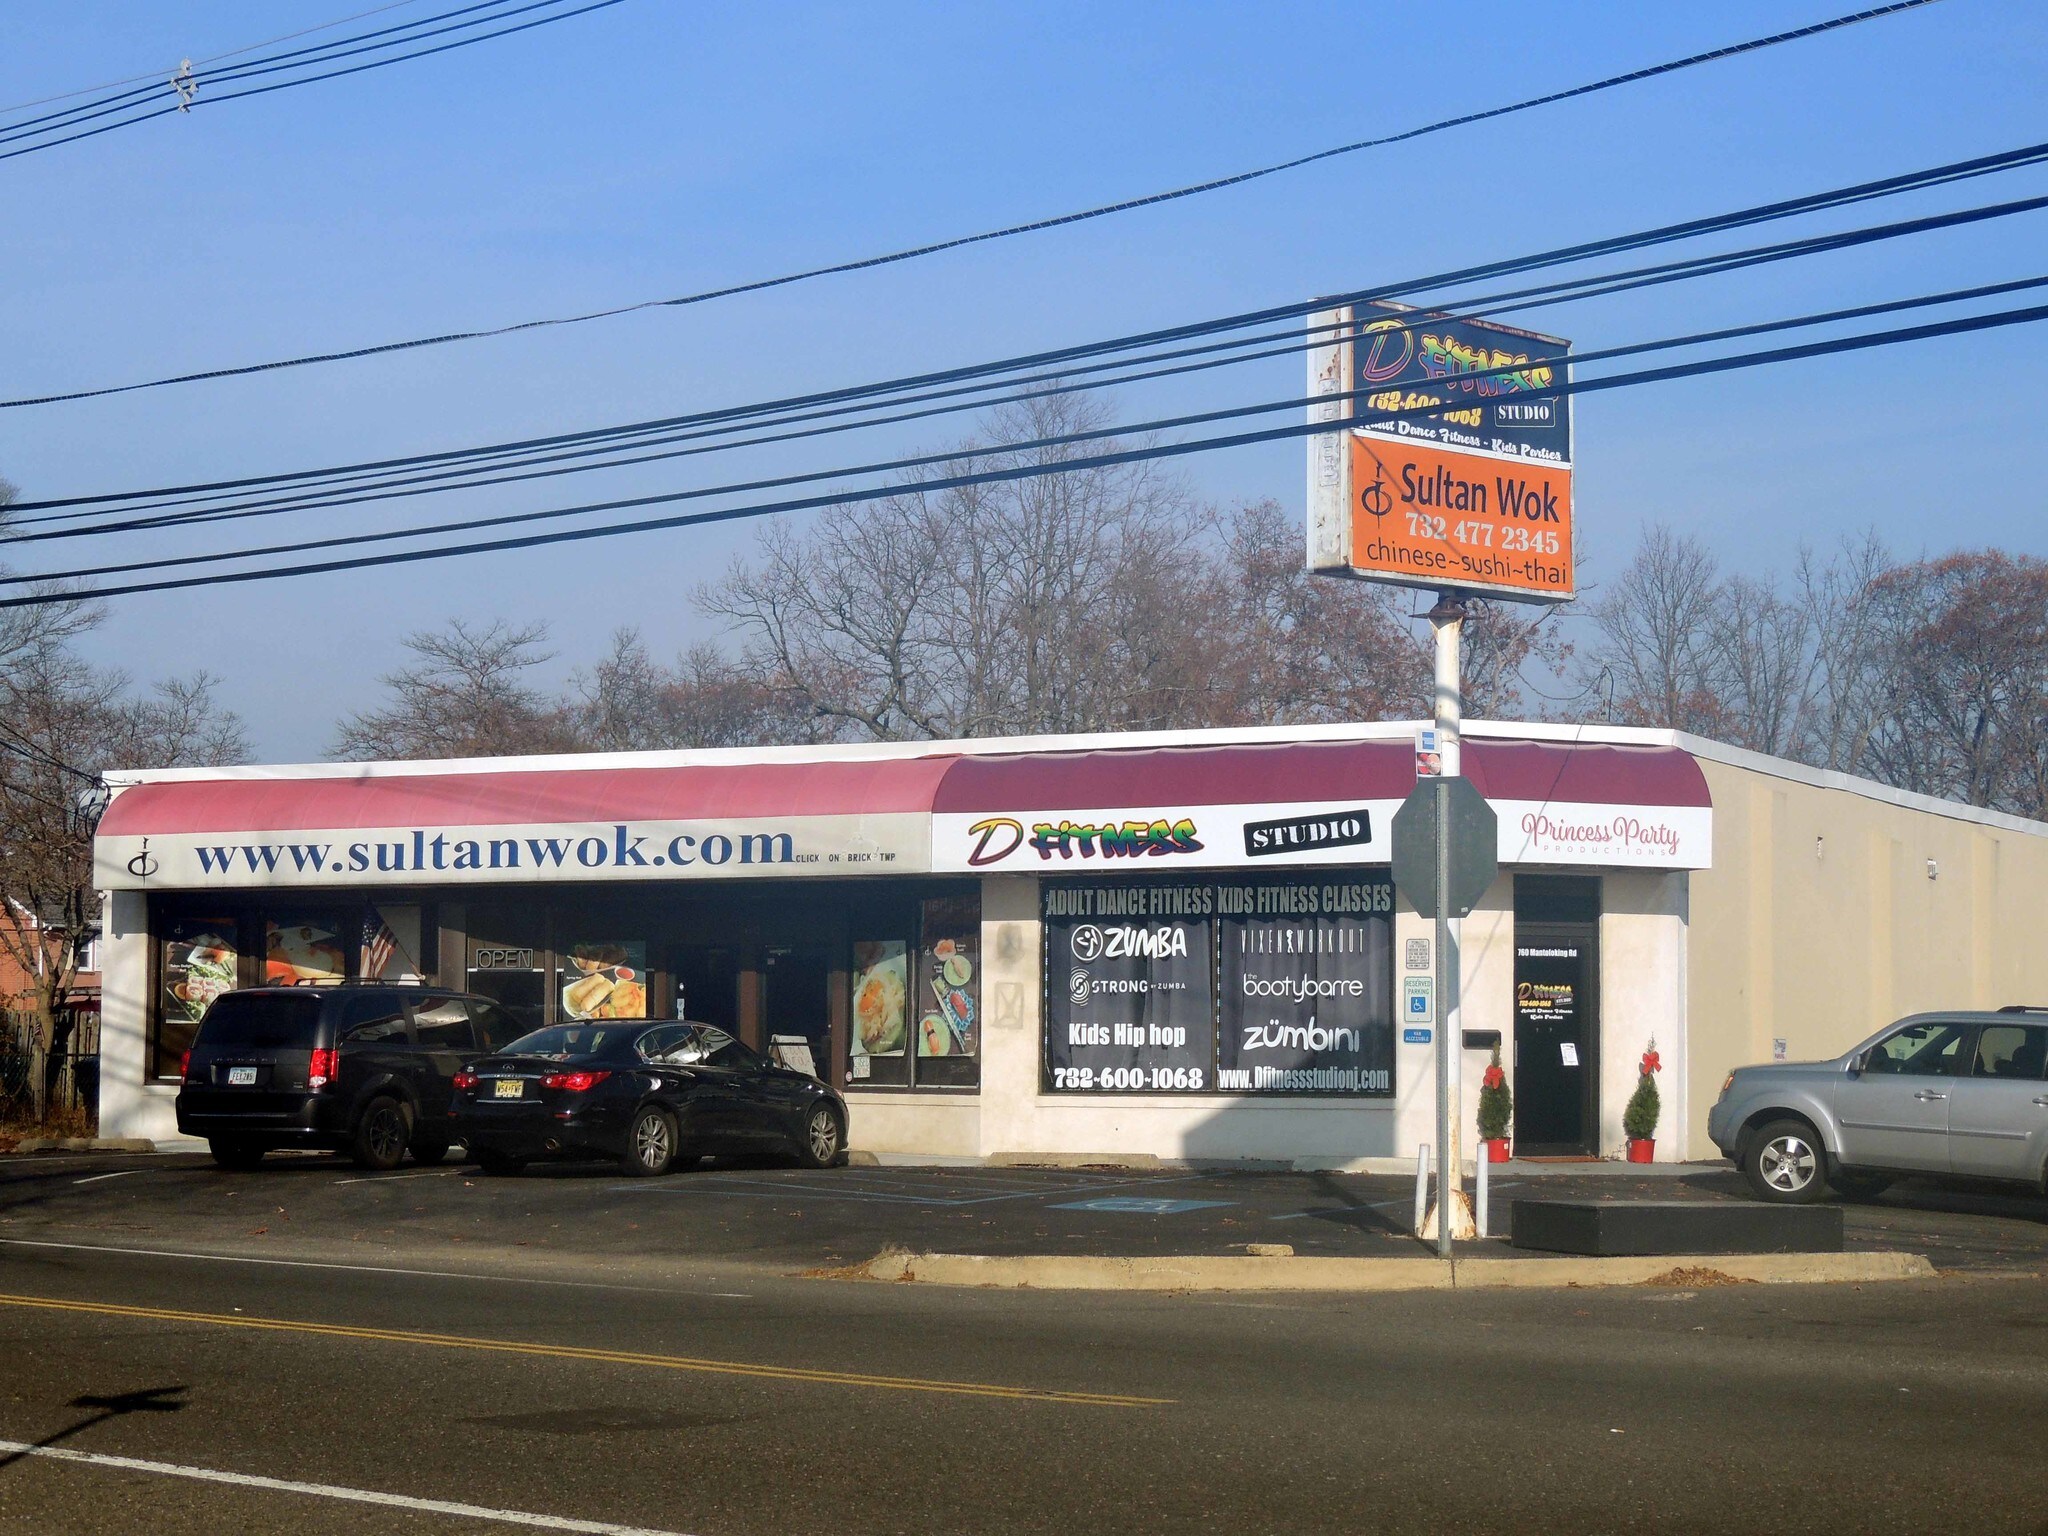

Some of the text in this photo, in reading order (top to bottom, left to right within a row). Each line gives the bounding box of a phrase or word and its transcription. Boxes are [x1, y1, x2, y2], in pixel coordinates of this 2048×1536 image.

[1363, 319, 1414, 382] D
[1497, 404, 1550, 421] STUDIO
[1397, 420, 1437, 438] Dance
[1438, 427, 1481, 447] Fitness
[1491, 438, 1518, 454] Kids
[1520, 443, 1562, 461] Parties
[1400, 462, 1561, 524] Sultan Wok
[1405, 511, 1561, 555] 732 477 2345
[967, 817, 1024, 866] D
[1252, 818, 1362, 849] STUDIO
[1521, 813, 1680, 856] Princess Party
[194, 825, 796, 875] www.sultanwok.com
[795, 852, 896, 863] CLICK ON BRICK TWP
[1543, 845, 1666, 856] PRODUCTIONS
[1047, 887, 1212, 916] ADULT DANCE FITNESS
[1217, 884, 1391, 914] KIDS FITNESS CLASSES
[1104, 926, 1188, 959] ZUMBA
[1241, 928, 1364, 954] VIXEN WORKOUT
[1517, 948, 1530, 957] 760
[1568, 948, 1577, 957] Rd
[478, 950, 531, 968] OPEN
[1091, 980, 1148, 993] STRONG
[1157, 982, 1186, 990] ZUMBA
[1243, 973, 1364, 1003] bootybarre
[1517, 982, 1532, 1000] D
[1068, 1023, 1186, 1047] Kids Hip hop
